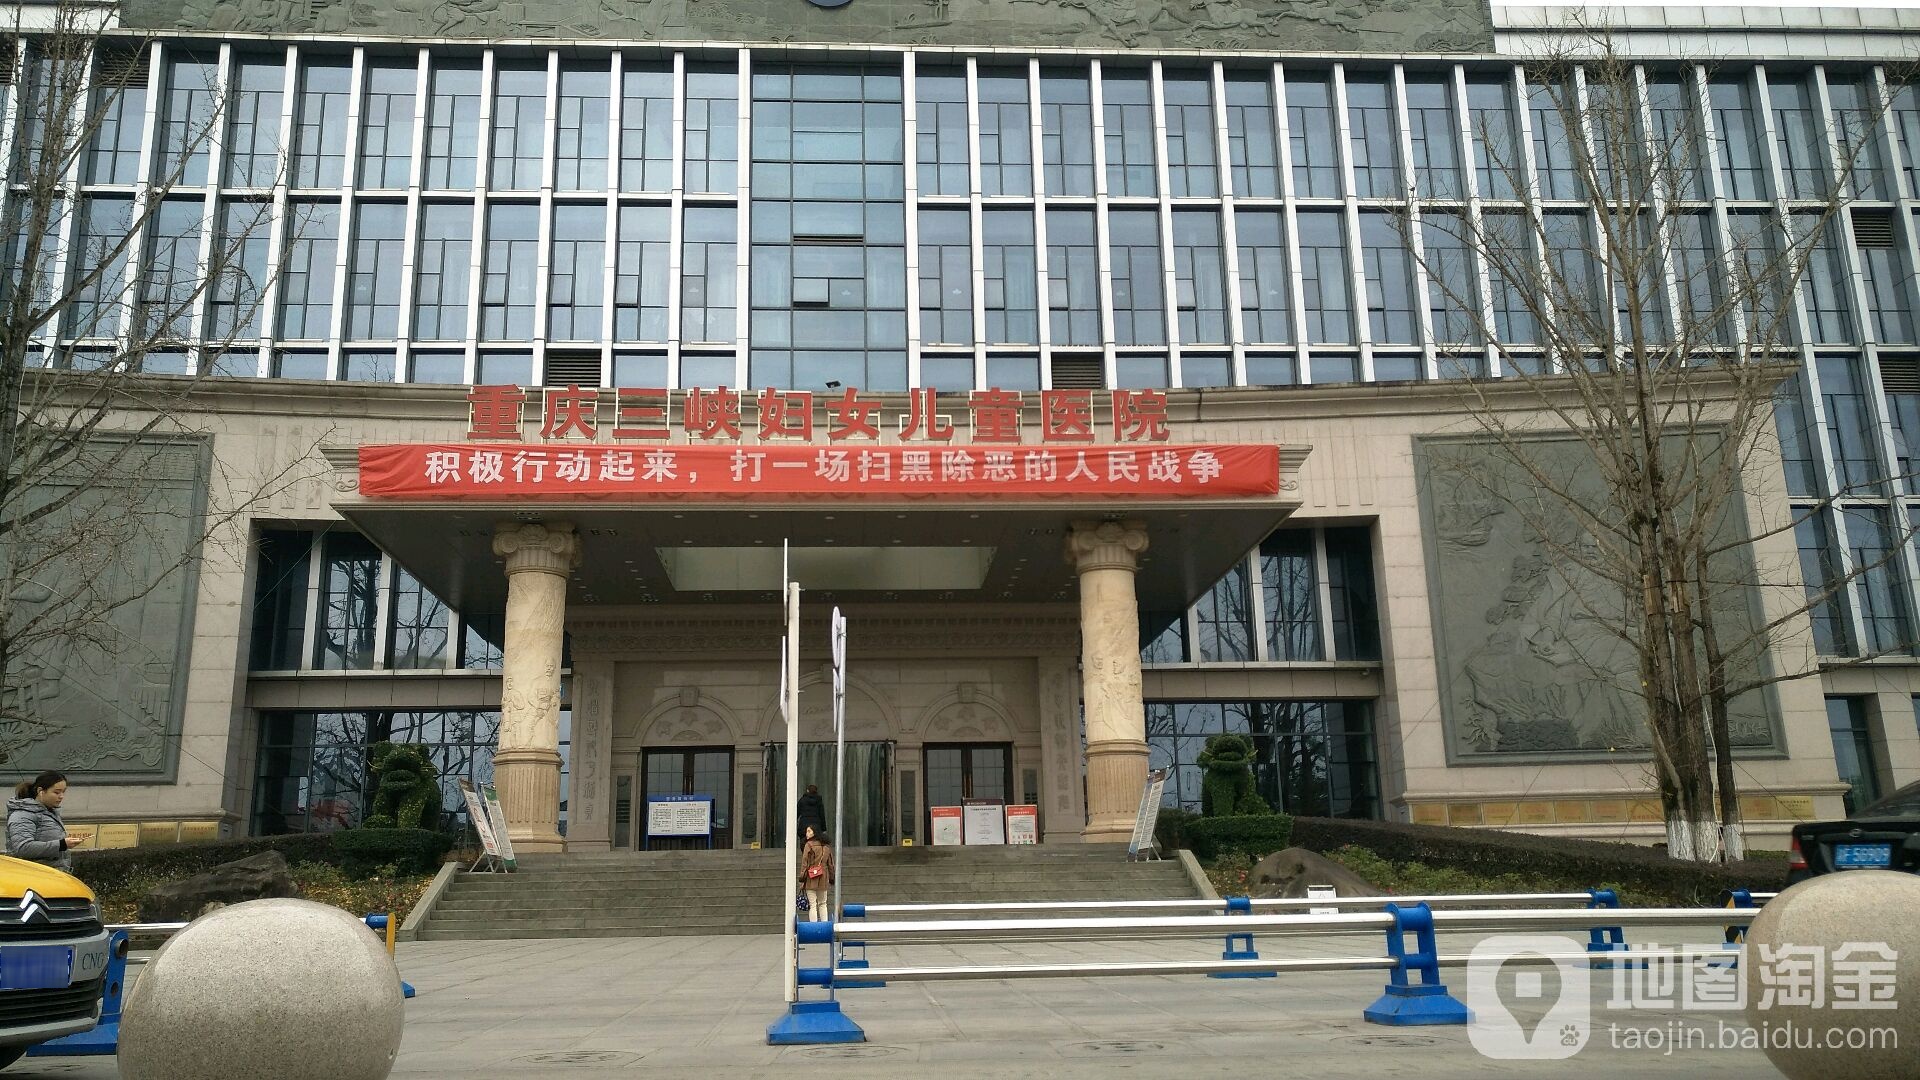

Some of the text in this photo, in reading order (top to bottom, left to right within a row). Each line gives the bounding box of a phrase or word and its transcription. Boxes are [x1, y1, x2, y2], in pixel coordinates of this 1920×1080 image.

[466, 384, 1171, 442] 重庆三峡妇女儿童医院
